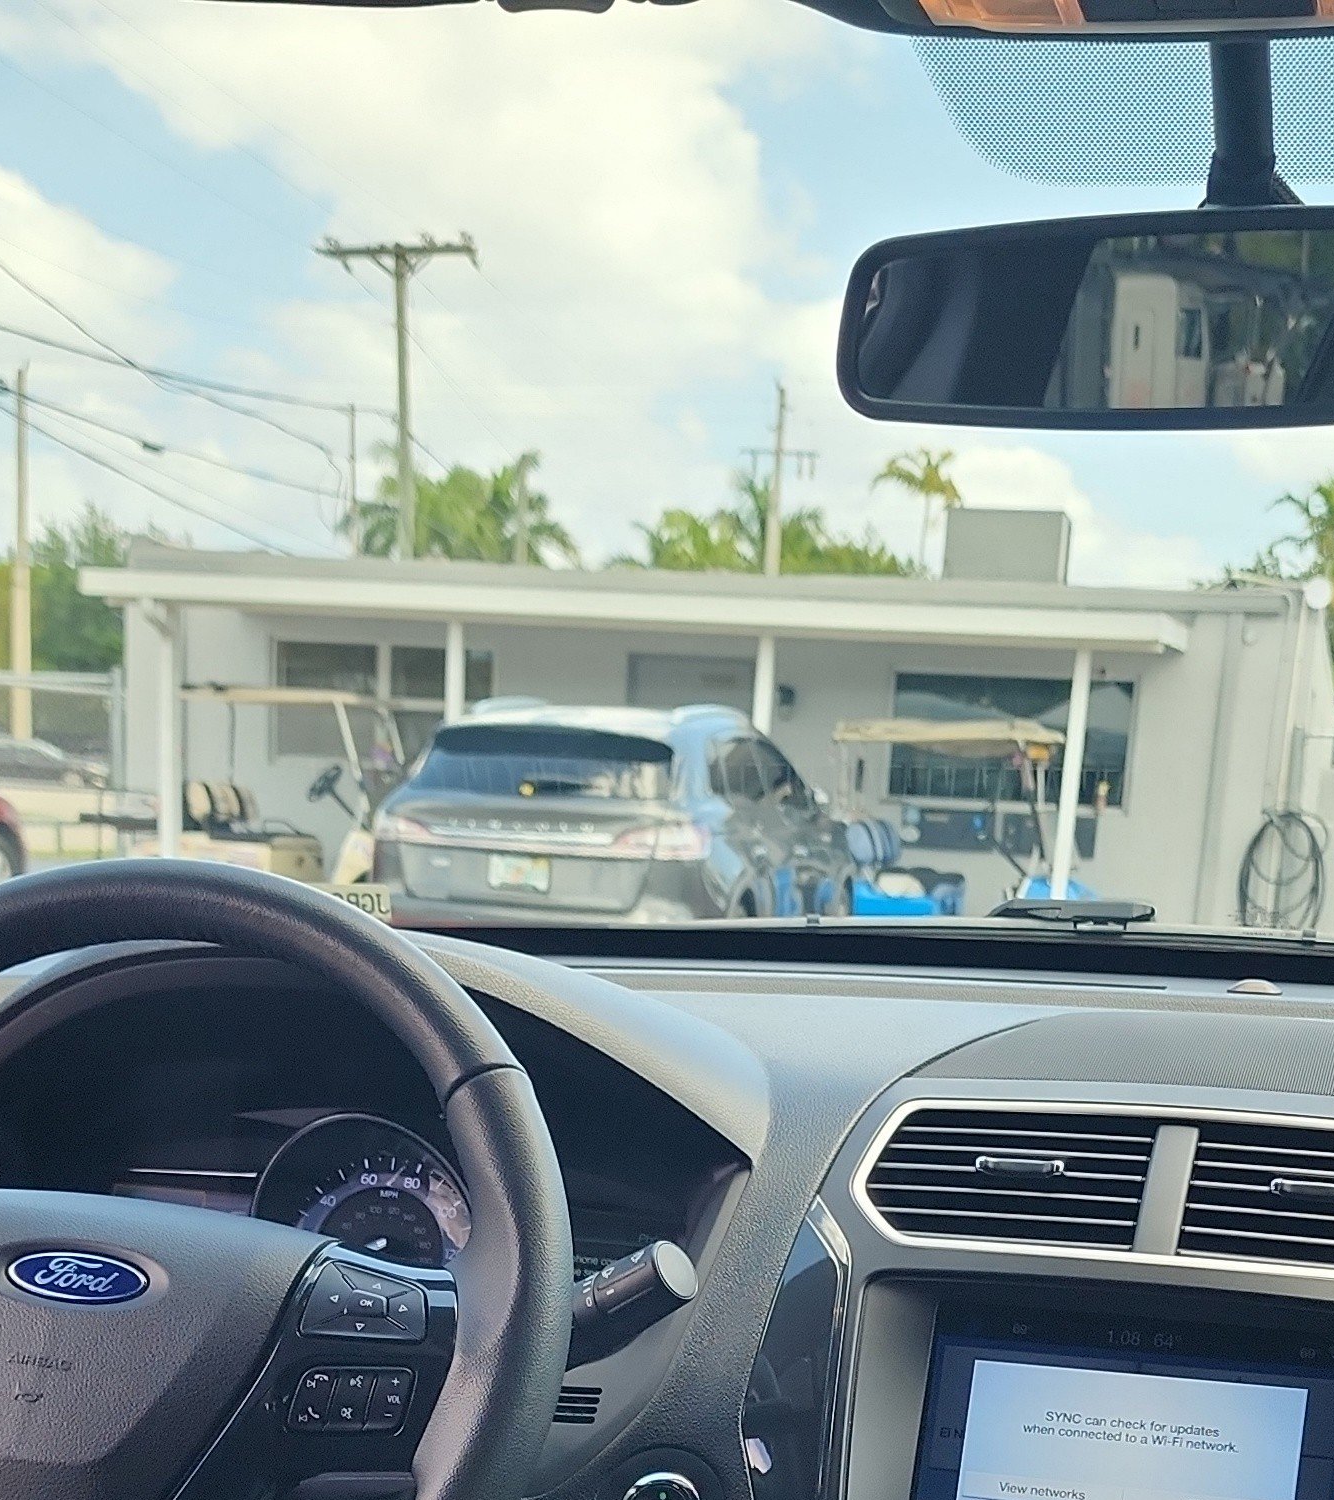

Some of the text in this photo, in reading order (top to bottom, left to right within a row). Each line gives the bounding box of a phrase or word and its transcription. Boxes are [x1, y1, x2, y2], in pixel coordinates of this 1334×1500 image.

[360, 1173, 378, 1186] 60
[403, 1177, 421, 1190] 80
[380, 1189, 399, 1199] MPH
[320, 1195, 337, 1207] 40
[34, 1257, 120, 1293] Ford
[359, 1299, 374, 1308] OK
[387, 1395, 401, 1405] VOL
[1045, 1411, 1221, 1438] SYNC can check for updates
[1023, 1424, 1239, 1453] when connected to a Wi-Fi network.
[999, 1481, 1086, 1500] View networks
